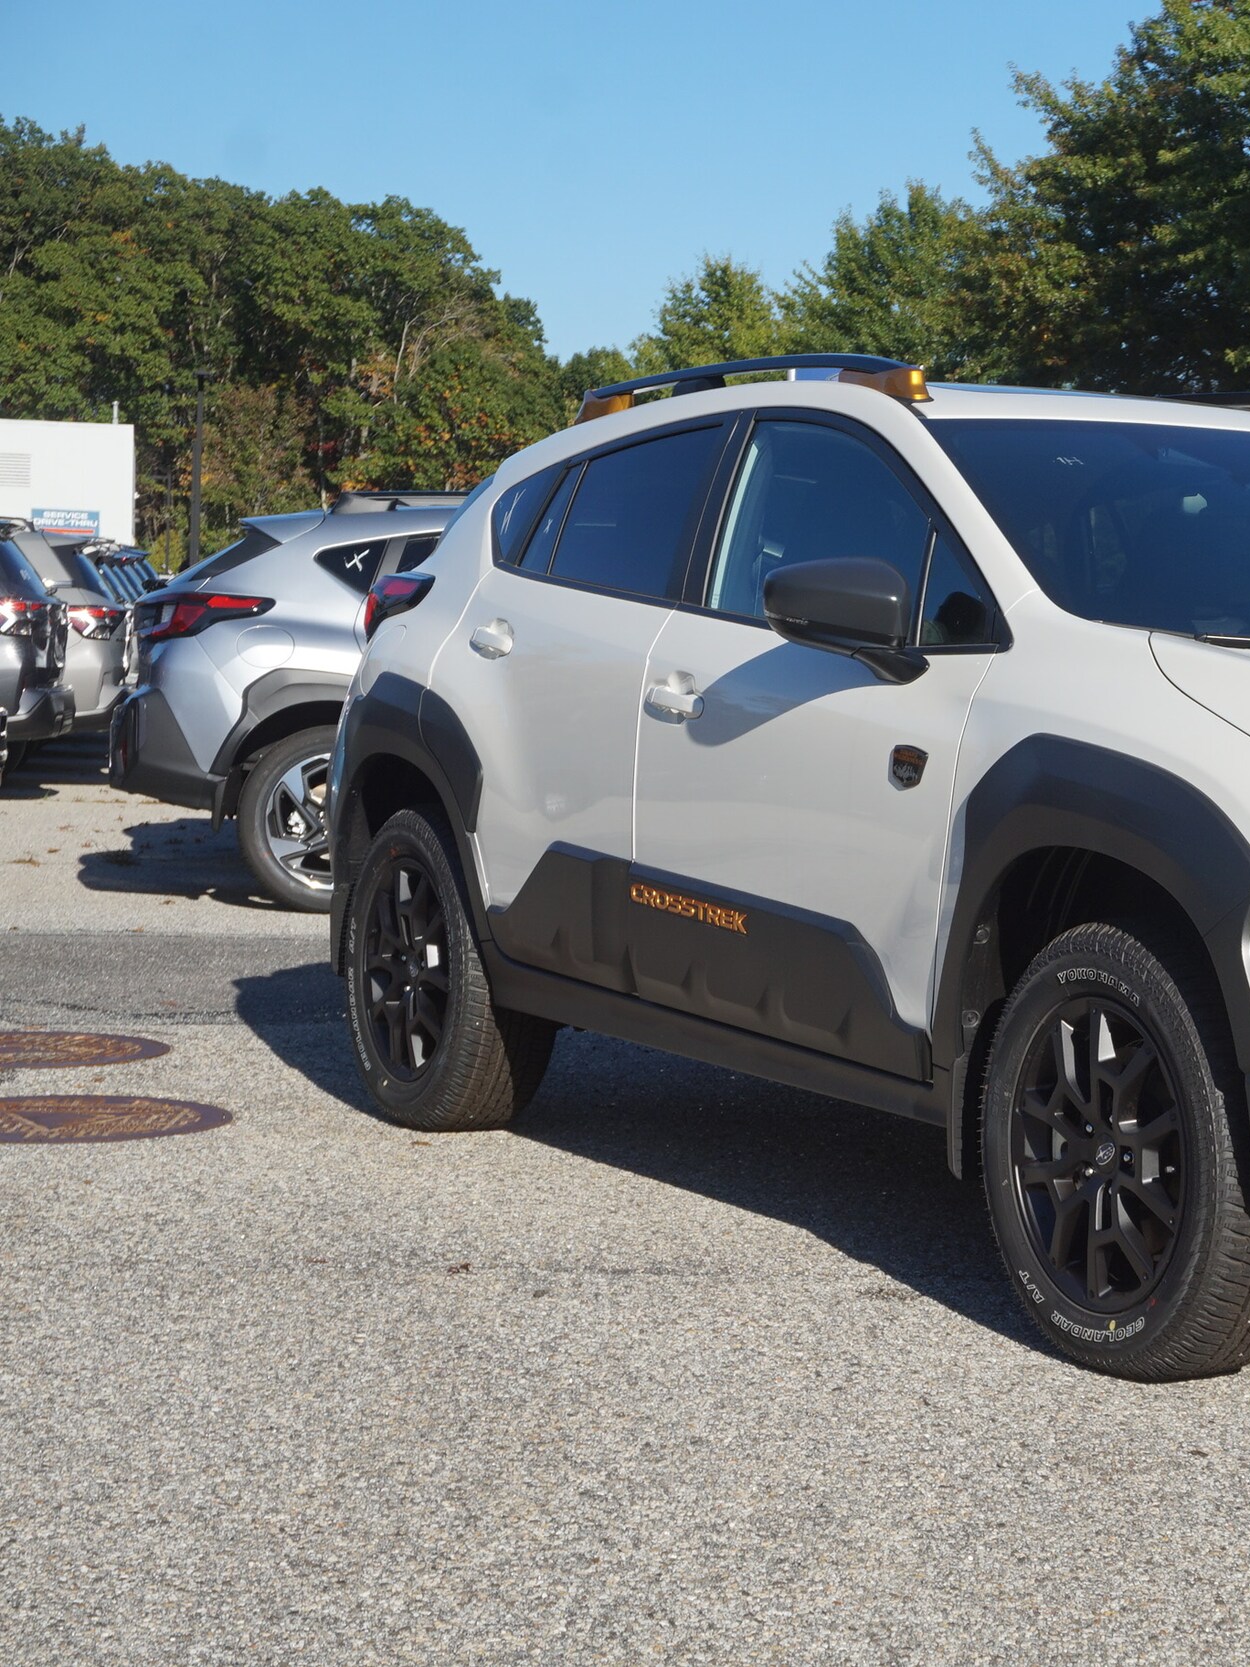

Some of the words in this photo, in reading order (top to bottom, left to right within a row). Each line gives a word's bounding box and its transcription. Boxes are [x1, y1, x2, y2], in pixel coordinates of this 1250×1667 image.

[43, 511, 88, 519] SERVICE
[629, 882, 747, 935] CROSSTREK
[1057, 967, 1140, 1007] YOKOHAMA
[1018, 1269, 1046, 1304] A/T
[1051, 1310, 1145, 1343] GEOLANDAR
